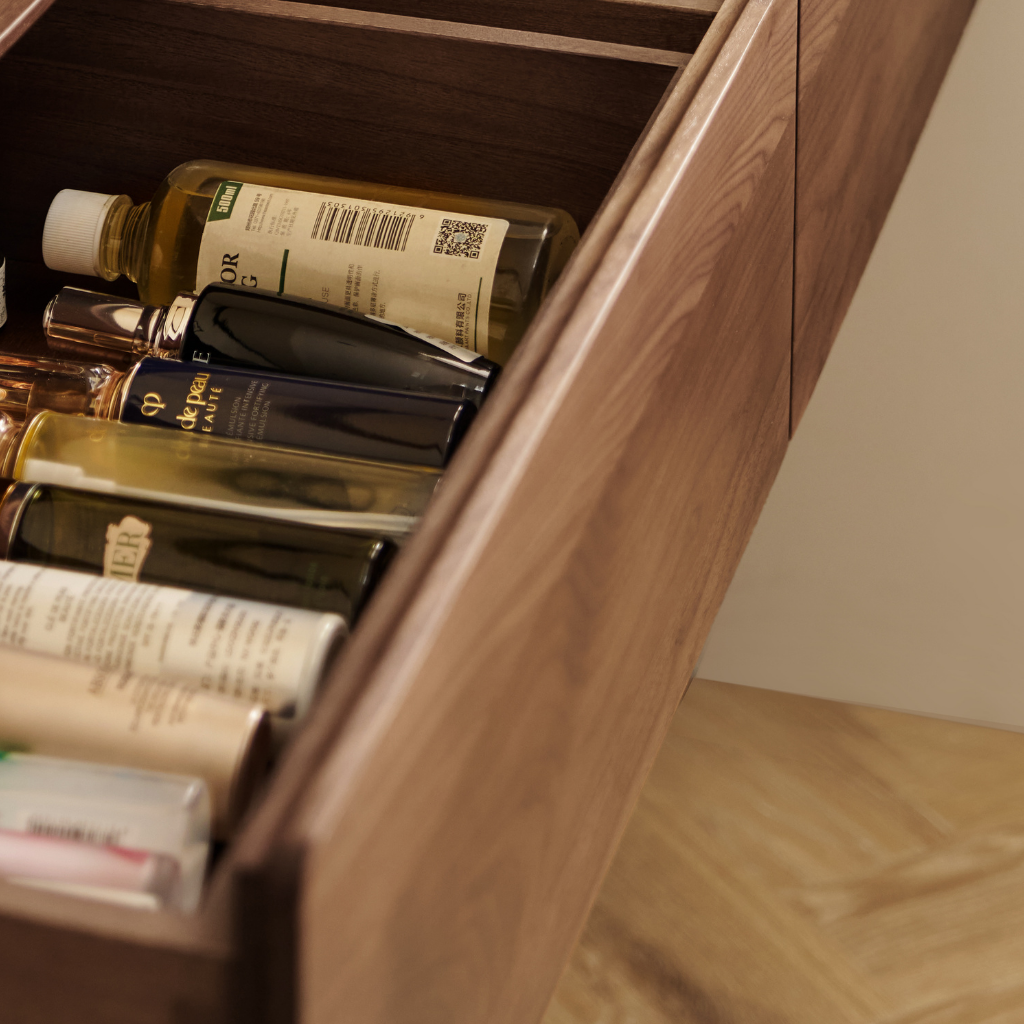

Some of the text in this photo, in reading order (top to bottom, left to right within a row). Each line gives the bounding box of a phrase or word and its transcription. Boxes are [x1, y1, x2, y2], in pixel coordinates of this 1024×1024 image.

[216, 185, 238, 213] 500ml
[220, 253, 240, 285] OR
[455, 292, 467, 347] 颜料有限公司
[176, 372, 211, 430] de peau
[201, 387, 223, 432] EAUTÉ
